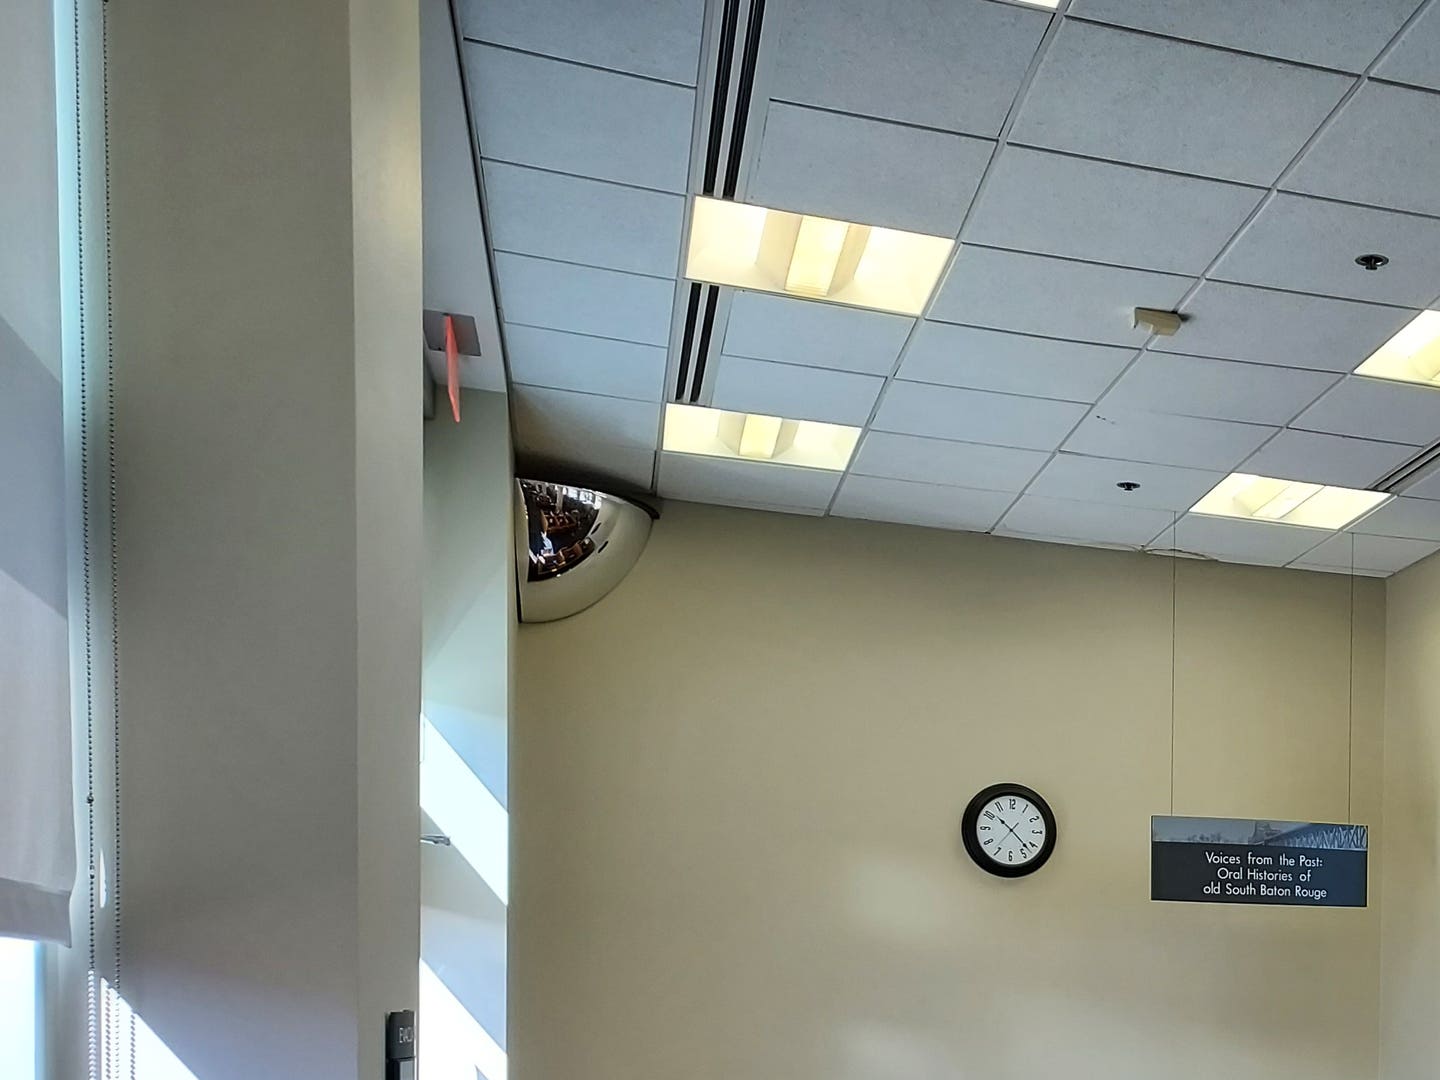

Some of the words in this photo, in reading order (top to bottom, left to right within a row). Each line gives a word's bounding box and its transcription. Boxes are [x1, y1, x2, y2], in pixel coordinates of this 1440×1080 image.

[995, 801, 1004, 813] 11
[1009, 799, 1016, 810] 12
[1022, 804, 1029, 813] 1
[983, 810, 995, 820] 10
[993, 847, 1002, 856] 7
[1008, 850, 1013, 861] 6
[1020, 848, 1027, 859] 5
[1205, 852, 1241, 865] Voices
[1248, 852, 1273, 865] from
[1279, 854, 1295, 866] the
[1299, 855, 1323, 867] Past:
[1217, 867, 1243, 880] Oral
[1247, 869, 1293, 882] Histories
[1299, 870, 1312, 882] of
[1203, 882, 1221, 895] old
[1225, 883, 1256, 895] South
[1260, 885, 1291, 897] Baton
[1295, 886, 1328, 900] Rouge
